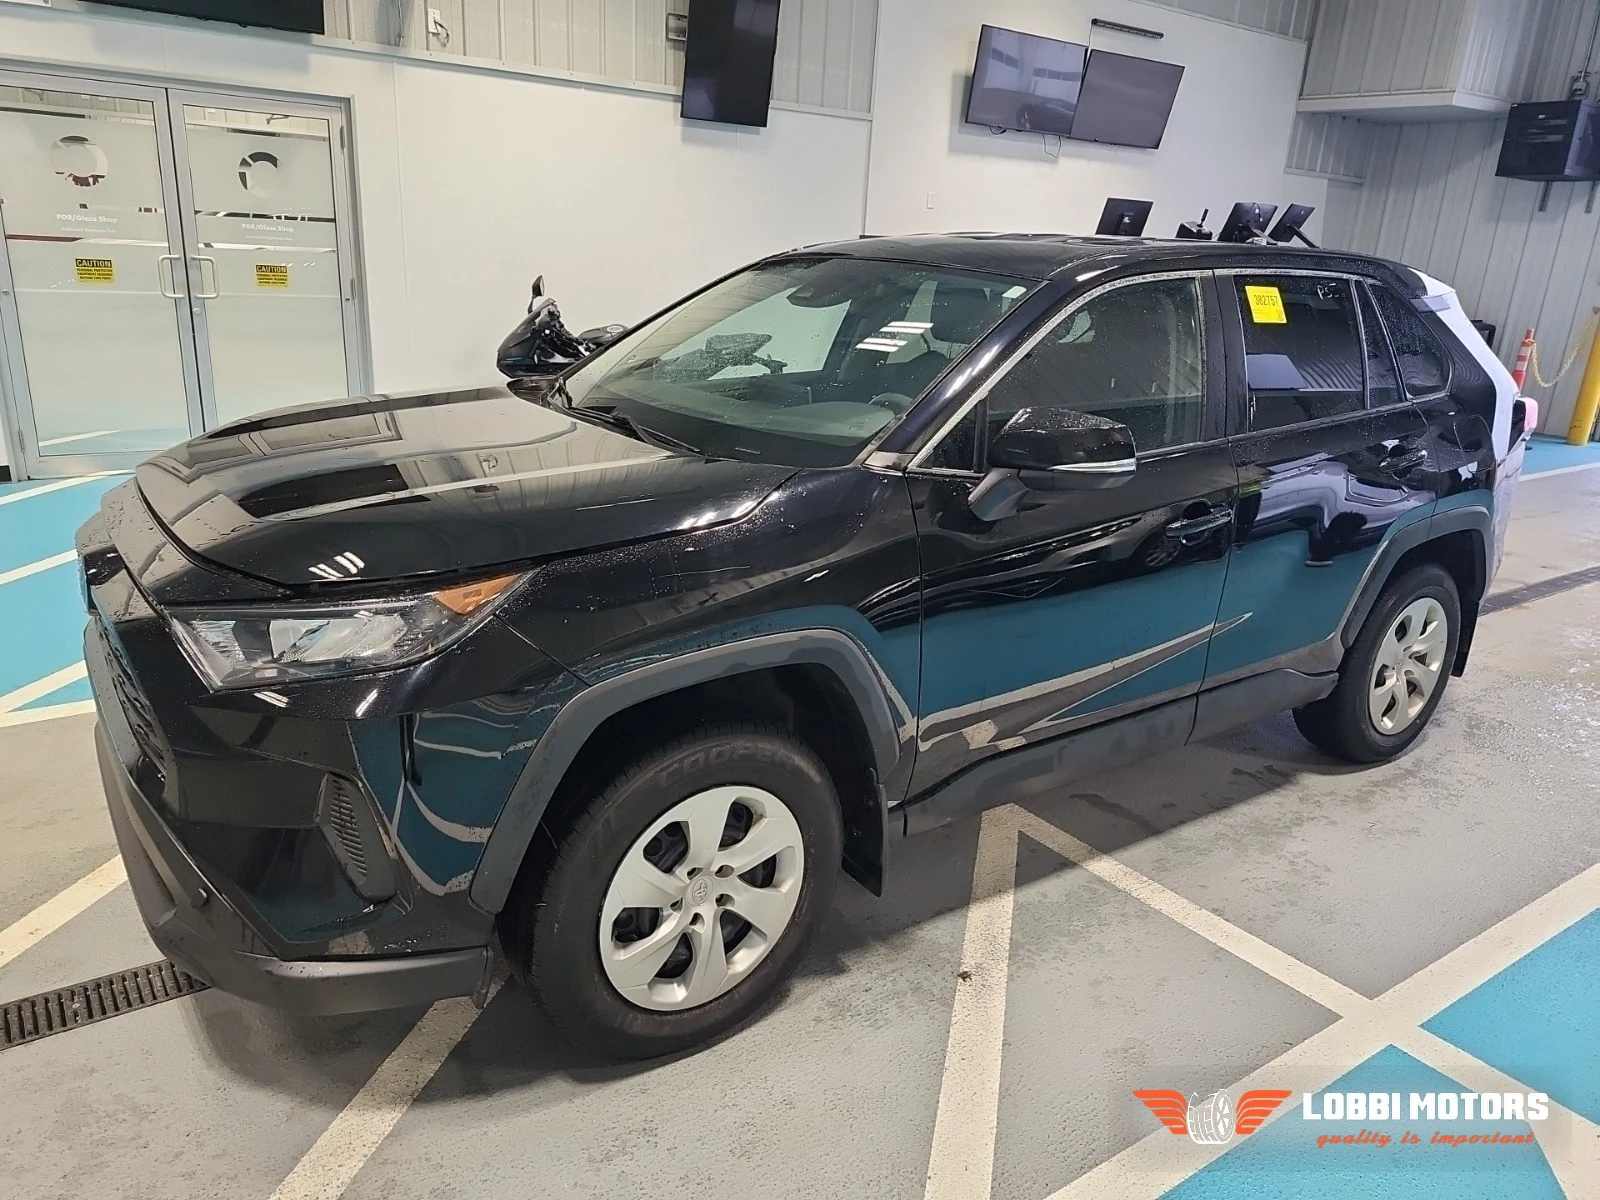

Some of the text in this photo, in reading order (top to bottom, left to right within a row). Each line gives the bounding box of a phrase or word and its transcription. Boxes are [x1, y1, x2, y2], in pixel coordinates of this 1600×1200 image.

[98, 215, 118, 224] Shop
[277, 225, 295, 233] Shop
[76, 259, 111, 267] CAUTION
[1253, 294, 1280, 307] 382757
